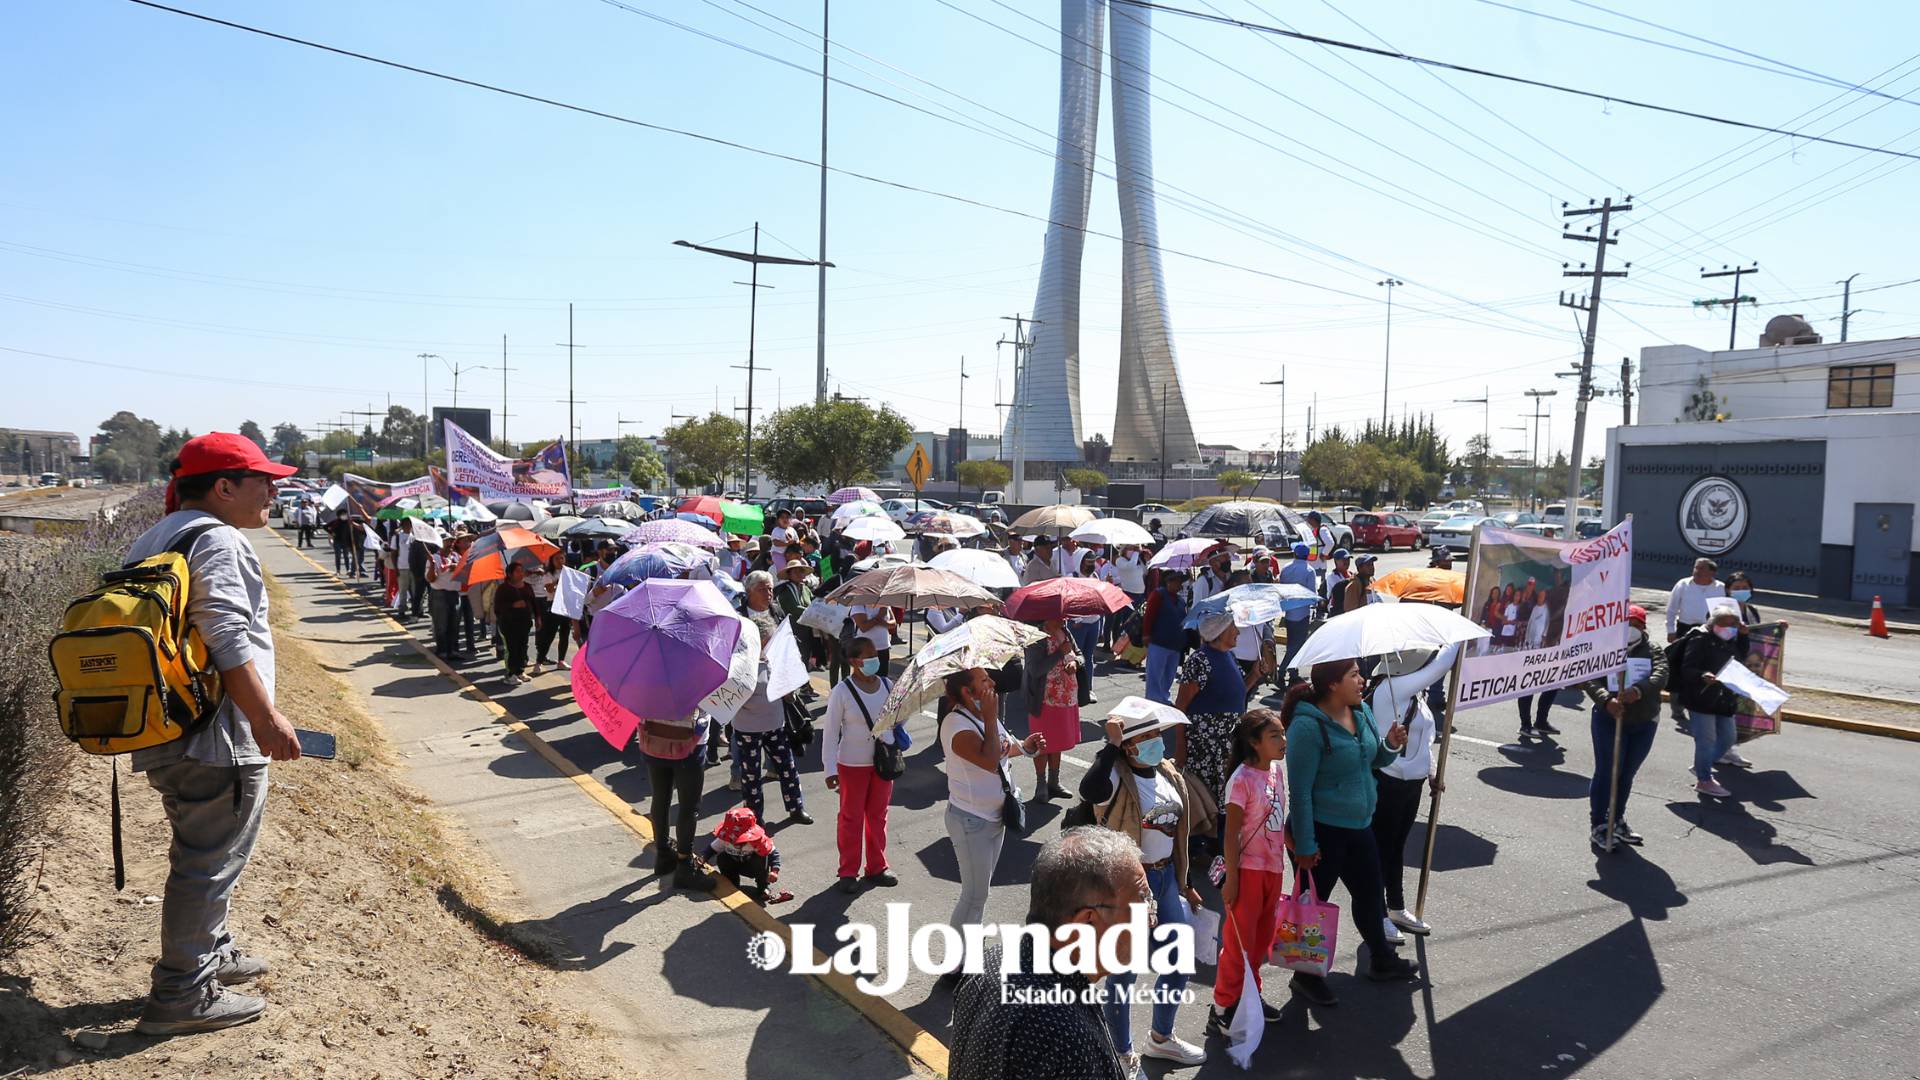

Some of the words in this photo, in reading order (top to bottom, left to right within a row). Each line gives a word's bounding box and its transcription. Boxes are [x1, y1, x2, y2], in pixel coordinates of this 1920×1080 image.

[404, 485, 430, 496] LETICIA
[455, 473, 489, 487] LETICIA
[489, 482, 508, 494] CRUZ
[509, 486, 560, 496] HERNANDEZ
[1566, 599, 1630, 639] LIBERTAD
[1523, 654, 1547, 667] PARA
[1548, 650, 1559, 663] LA
[1560, 642, 1593, 661] MAESTRA
[1460, 674, 1517, 702] LETICIA
[1520, 666, 1559, 690] CRUZ
[1558, 647, 1628, 682] HERNANDEZ
